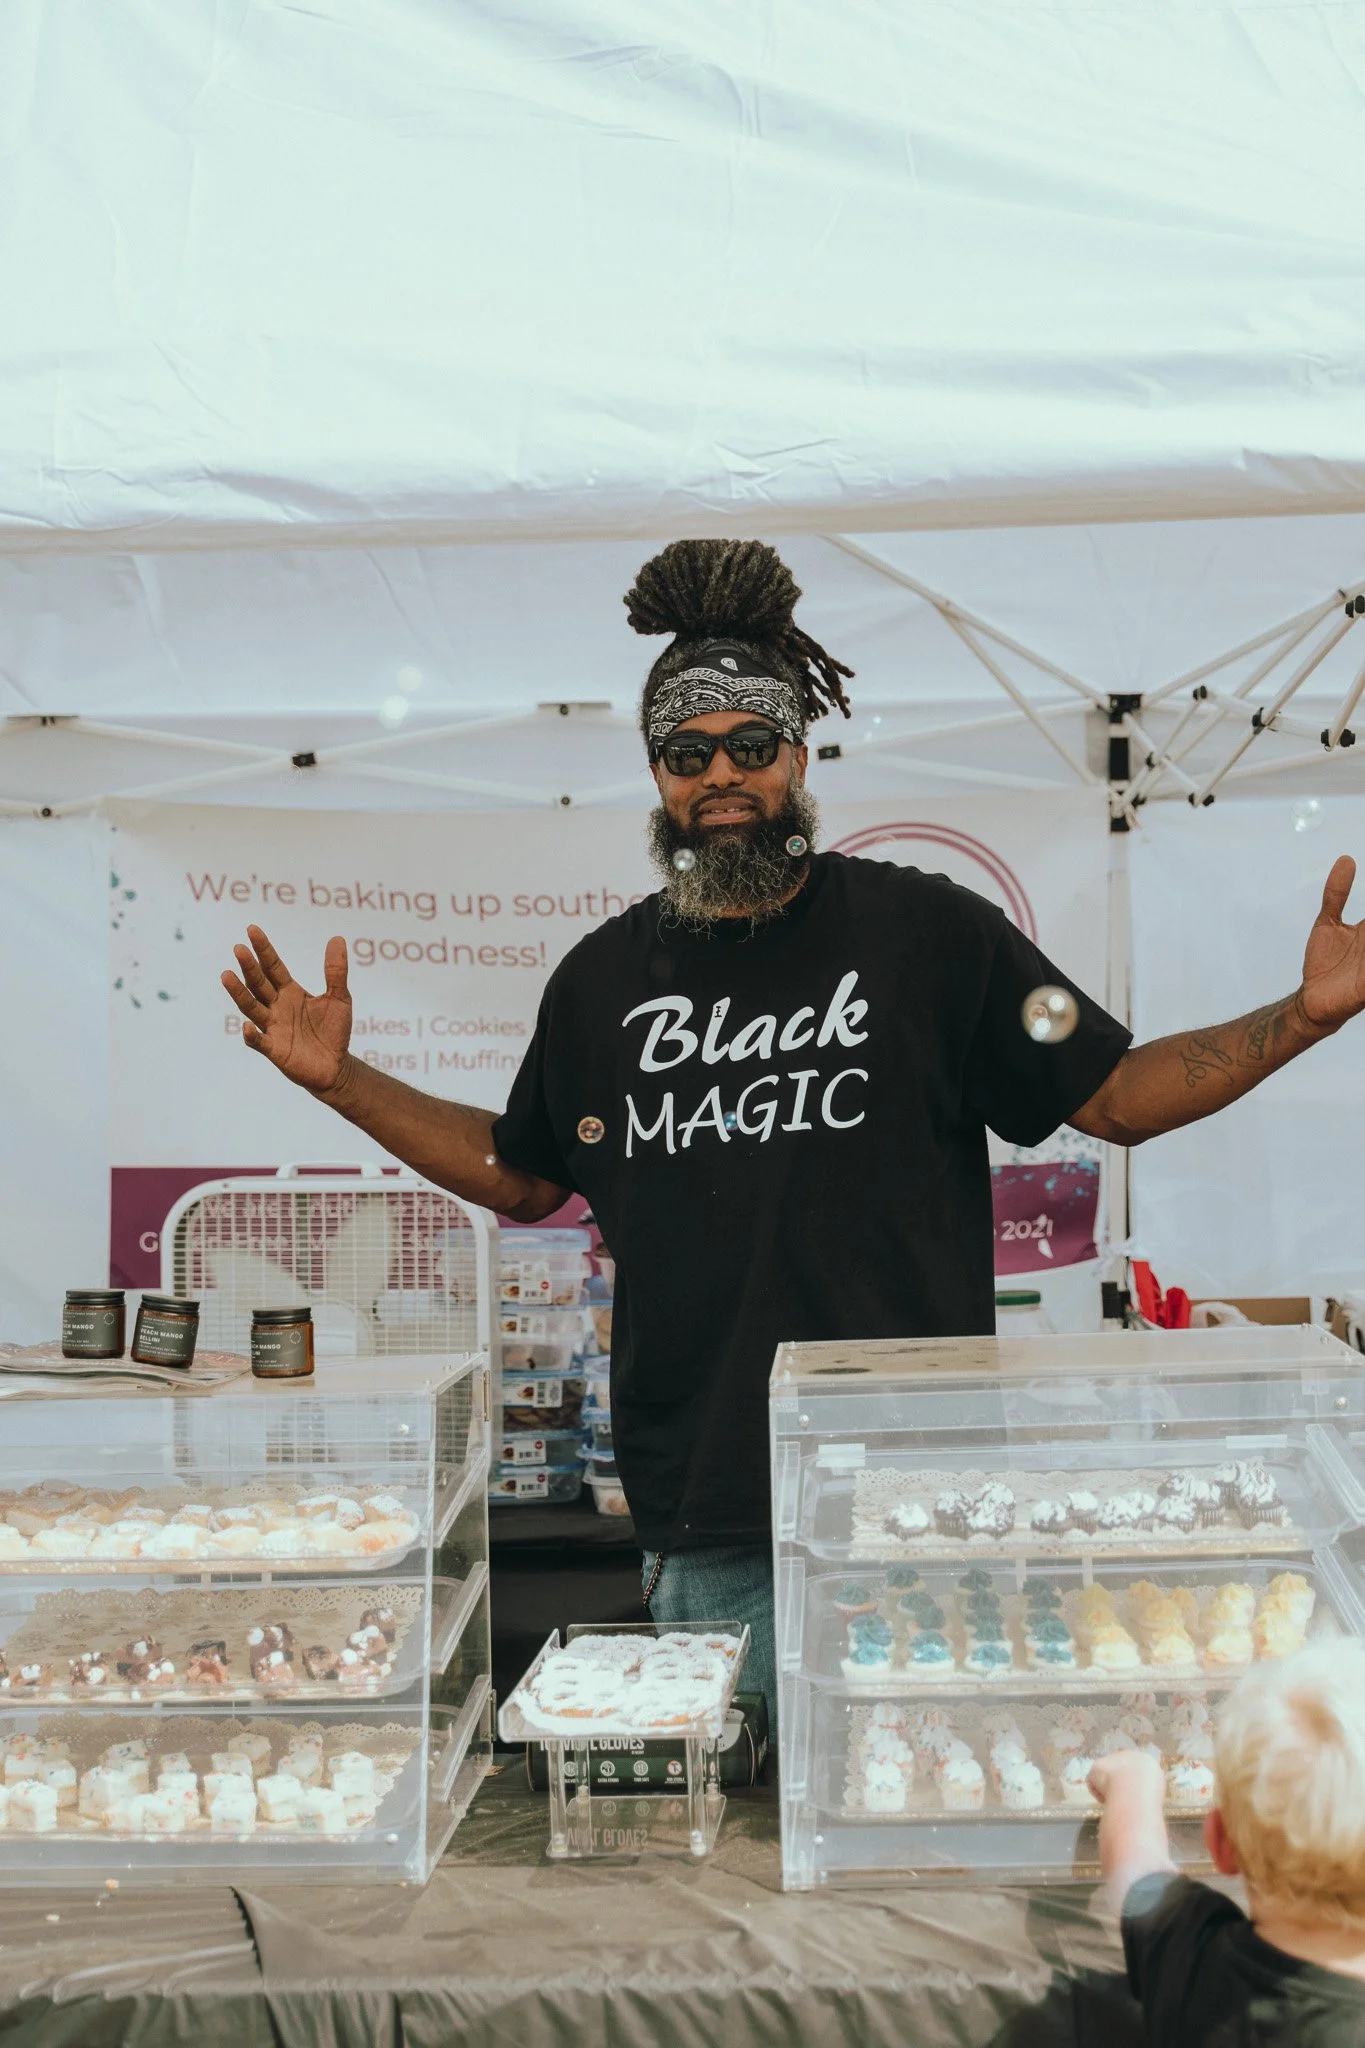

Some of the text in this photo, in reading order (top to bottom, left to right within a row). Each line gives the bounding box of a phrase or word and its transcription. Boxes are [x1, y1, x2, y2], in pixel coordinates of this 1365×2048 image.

[186, 872, 297, 905] We're
[308, 878, 437, 921] baking
[451, 893, 502, 921] up
[352, 936, 548, 968] goodness!
[354, 1015, 526, 1037] akes Cookies
[622, 970, 869, 1072] Black
[363, 1050, 417, 1071] Bars
[625, 1068, 869, 1158] MAGIC
[1000, 1219, 1054, 1241] 2021
[140, 1328, 184, 1339] PEACH MANGO
[140, 1334, 160, 1343] BELLINI
[600, 1737, 645, 1751] GLOVES
